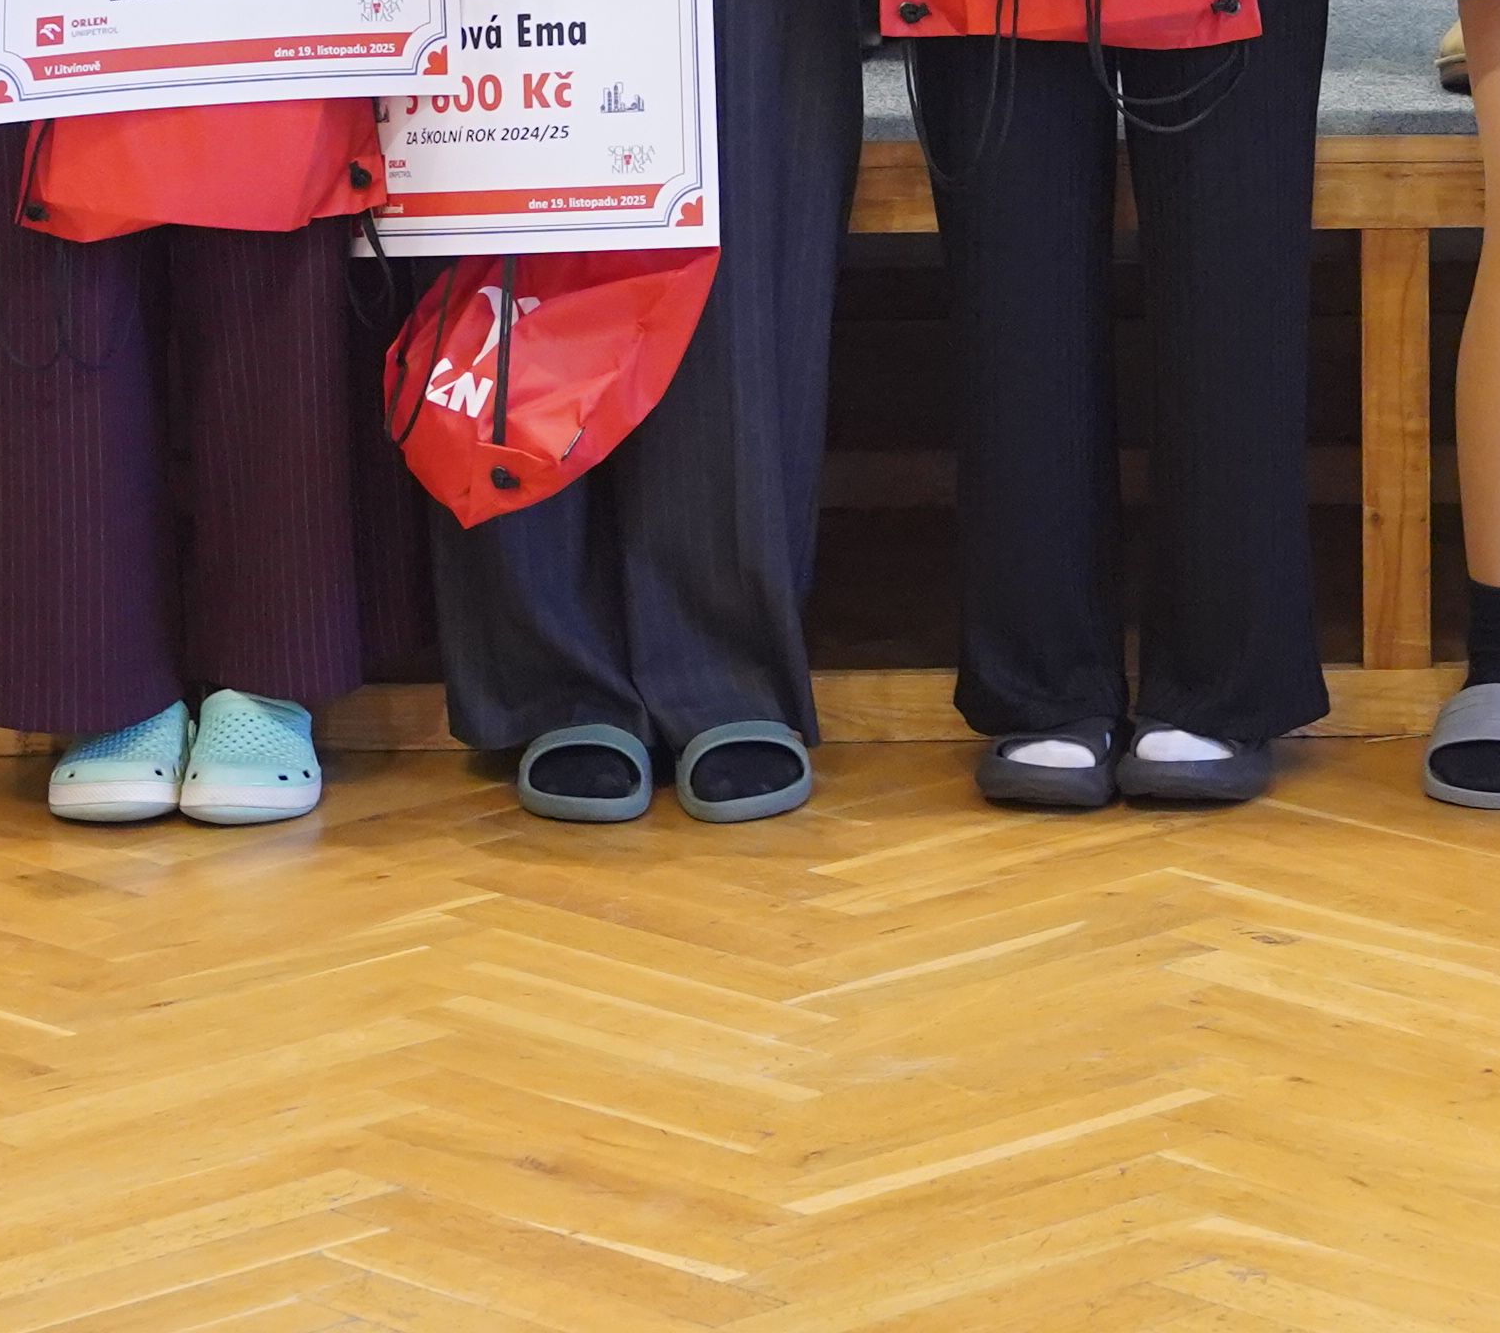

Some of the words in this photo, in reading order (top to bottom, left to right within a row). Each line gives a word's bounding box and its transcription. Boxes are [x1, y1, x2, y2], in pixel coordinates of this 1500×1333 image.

[517, 13, 587, 48] Ema
[523, 70, 574, 109] Kč
[465, 129, 495, 142] ROK
[501, 125, 570, 141] 2024/25
